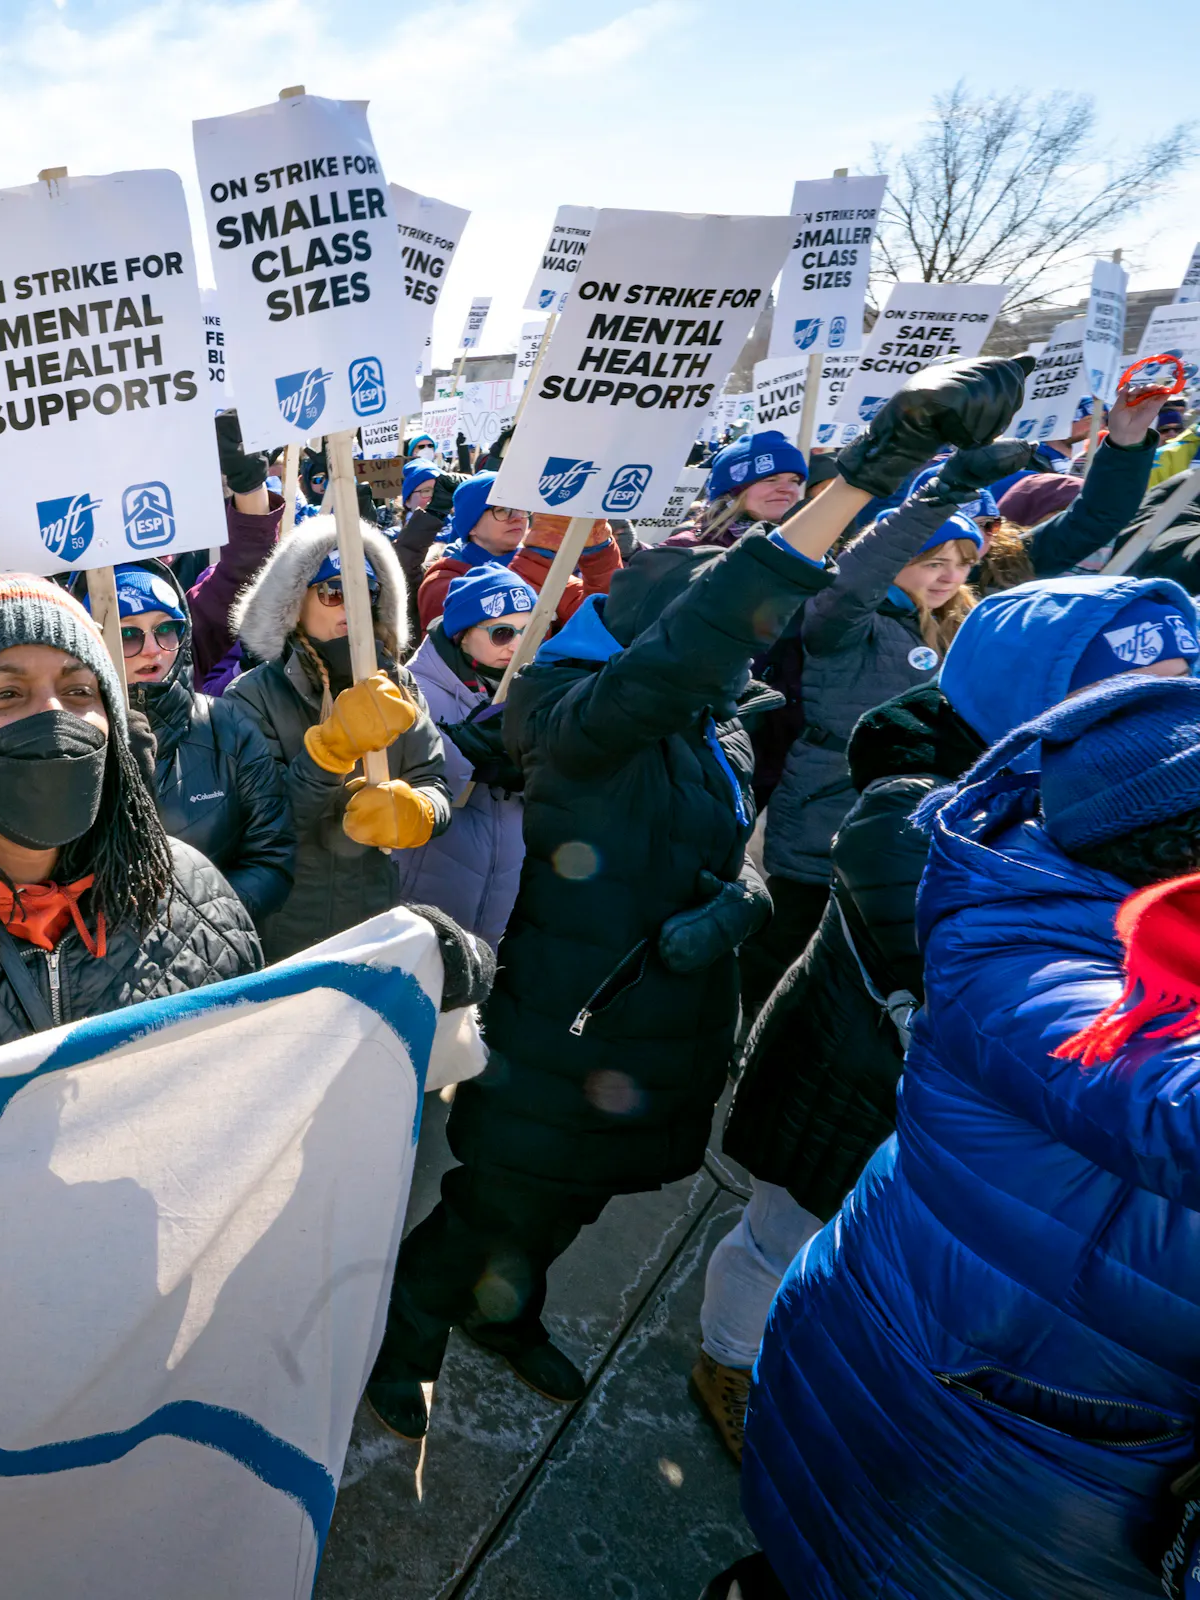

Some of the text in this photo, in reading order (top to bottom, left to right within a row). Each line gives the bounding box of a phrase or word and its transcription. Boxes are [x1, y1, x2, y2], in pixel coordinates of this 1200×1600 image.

[210, 155, 379, 203] ON STRIKE FOR
[216, 187, 388, 250] SMALLER
[816, 210, 855, 223] STRIKE
[856, 209, 877, 220] FOR
[554, 225, 592, 238] ON STRIKE
[792, 227, 872, 249] SMALLER
[433, 236, 456, 252] FOR
[548, 238, 588, 256] LIVIN
[251, 229, 372, 283] CLASS
[541, 255, 582, 273] WAG
[802, 249, 858, 269] CLASS
[13, 260, 119, 301] STRIKE
[125, 251, 184, 282] FOR
[802, 271, 853, 291] SIZES
[266, 271, 371, 322] SIZES
[578, 280, 762, 309] ON STRIKE FOR
[884, 309, 990, 323] ON STRIKE FOR
[586, 313, 725, 347] MENTAL
[896, 325, 957, 343] SAFE,
[878, 342, 962, 359] STABLE
[4, 334, 163, 392] HEALTH
[577, 346, 713, 379] HEALTH
[859, 358, 929, 375] SCHO
[1033, 351, 1084, 372] SMALLE
[757, 369, 804, 389] ON STRIKE
[1035, 367, 1080, 386] CLASS
[280, 367, 335, 429] mft
[359, 388, 378, 402] ESP
[538, 375, 716, 410] SUPPORTS
[760, 381, 806, 407] LIVIN
[1030, 382, 1071, 401] SIZES
[305, 406, 318, 419] 59
[757, 400, 801, 425] WAG
[364, 423, 399, 437] LIVING
[364, 433, 400, 446] WAGES
[540, 460, 602, 498] mft
[558, 489, 570, 499] 59
[614, 490, 633, 501] ESP
[40, 493, 103, 557] mft
[137, 517, 163, 535] ESP
[638, 517, 681, 528] SCHOOLS
[71, 536, 85, 550] 59
[1114, 621, 1164, 662] mft
